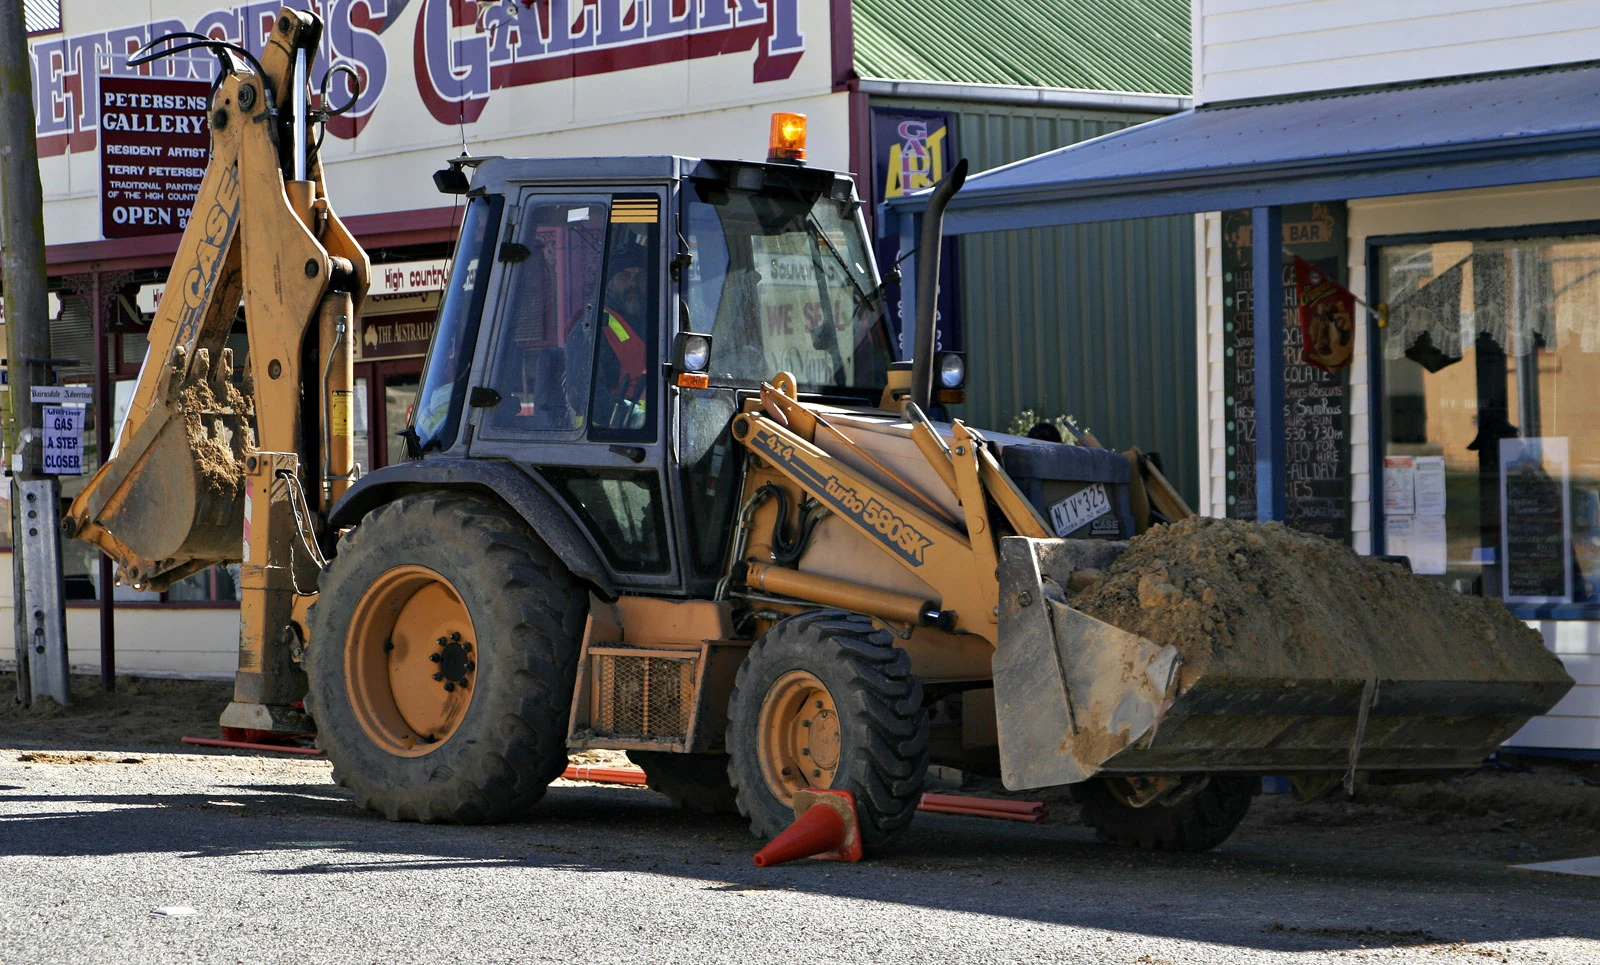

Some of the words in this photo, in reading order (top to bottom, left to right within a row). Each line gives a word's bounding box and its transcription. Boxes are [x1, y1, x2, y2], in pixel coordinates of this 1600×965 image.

[28, 0, 388, 140] ETERSES
[422, 0, 806, 104] GALL
[104, 93, 207, 110] PETERSENS
[102, 112, 206, 134] GALLERY
[106, 144, 162, 156] RESIDENT
[167, 148, 207, 158] ARTIST
[107, 165, 145, 176] TERRY
[149, 166, 207, 178] PETERSEN
[109, 181, 161, 190] TRADITIONAL
[107, 191, 119, 199] OF
[144, 192, 164, 200] HIGH
[167, 193, 200, 201] COUNT
[112, 206, 172, 225] OPEN
[183, 165, 240, 309] CASE
[1289, 224, 1320, 241] BAR
[385, 267, 404, 291] High
[767, 304, 794, 336] WE
[803, 301, 845, 333] SEL
[378, 325, 393, 344] THE
[394, 320, 433, 343] AUSTRALI
[54, 418, 73, 431] GAS
[47, 437, 54, 449] A
[56, 437, 78, 449] STEP
[766, 433, 795, 462] 4x4
[45, 455, 80, 468] CLOSER
[823, 474, 865, 515] turbo
[862, 497, 935, 567] 580SK
[1092, 520, 1120, 530] CASE
